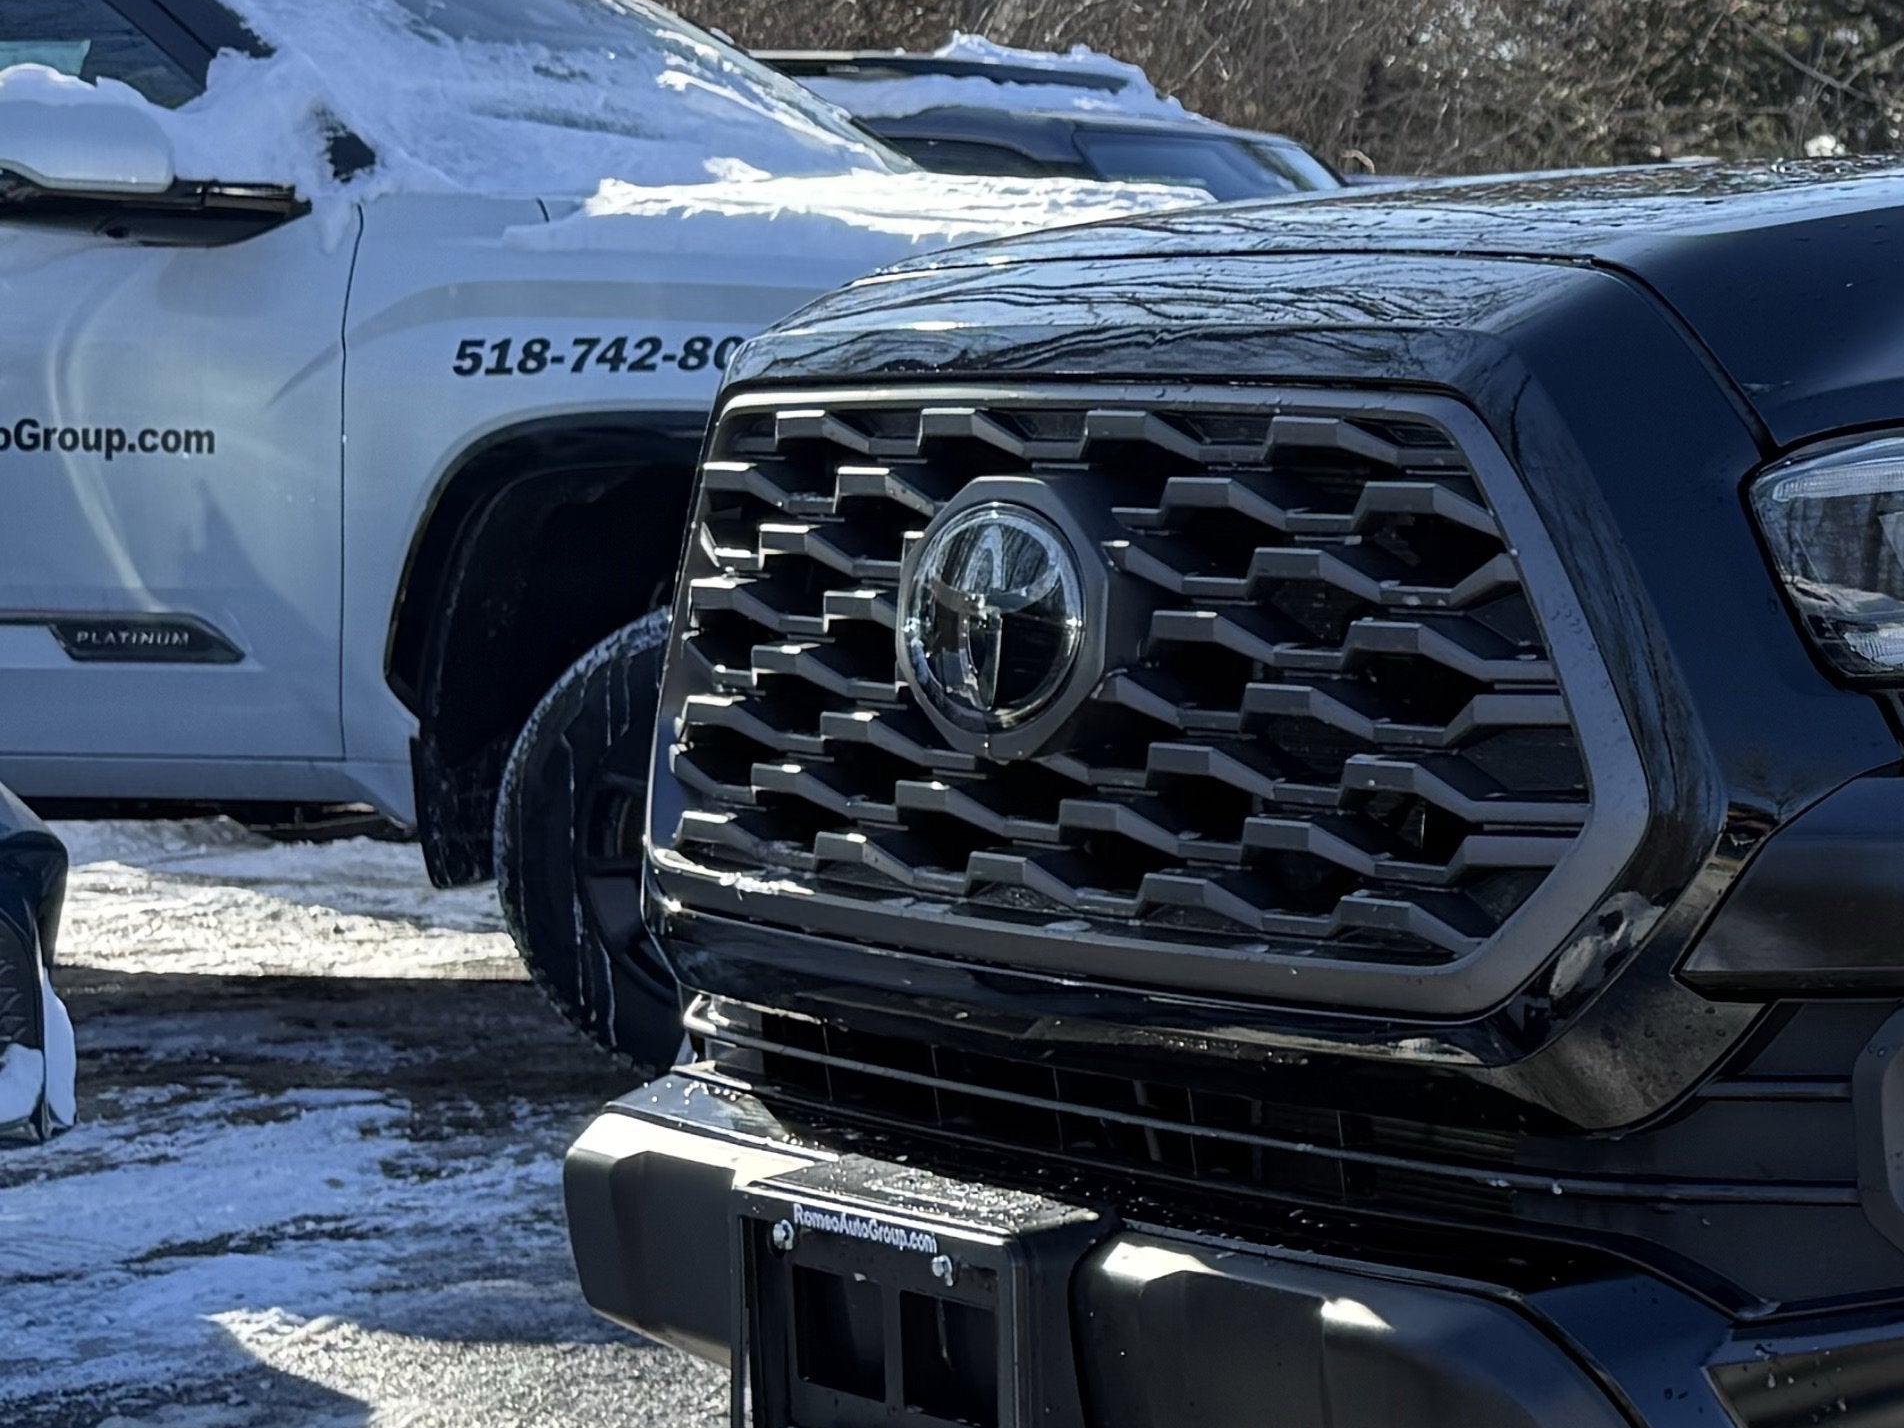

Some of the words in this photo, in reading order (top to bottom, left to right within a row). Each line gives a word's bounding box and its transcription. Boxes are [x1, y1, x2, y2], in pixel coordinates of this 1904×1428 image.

[0, 418, 216, 462] oGroup.com
[76, 630, 189, 645] PLATINUM
[793, 1202, 938, 1254] RomeoAutoGroup.com
